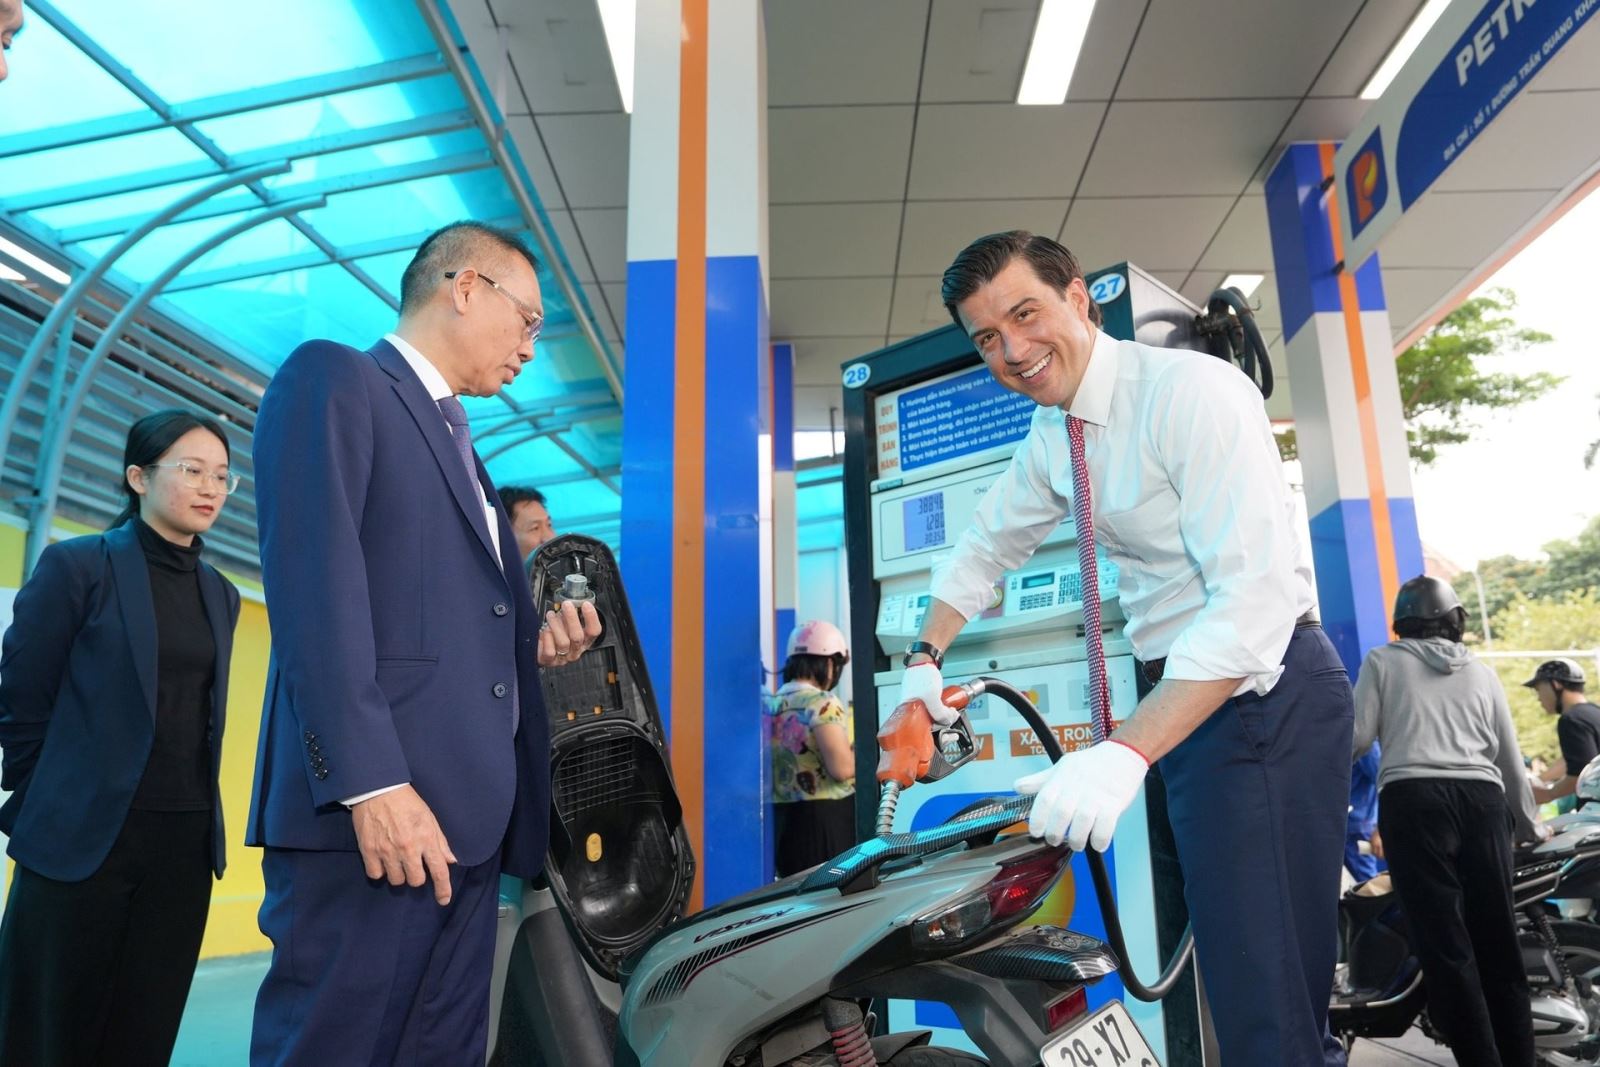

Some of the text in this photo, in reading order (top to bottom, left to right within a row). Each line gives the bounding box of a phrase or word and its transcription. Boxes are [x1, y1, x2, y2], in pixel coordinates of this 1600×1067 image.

[1541, 16, 1574, 55] QUANG
[1093, 276, 1121, 300] 27
[847, 366, 867, 385] 28
[939, 386, 956, 397] khách
[918, 404, 935, 414] khách
[919, 415, 936, 425] khách
[920, 438, 937, 448] khách
[1064, 726, 1093, 741] RON
